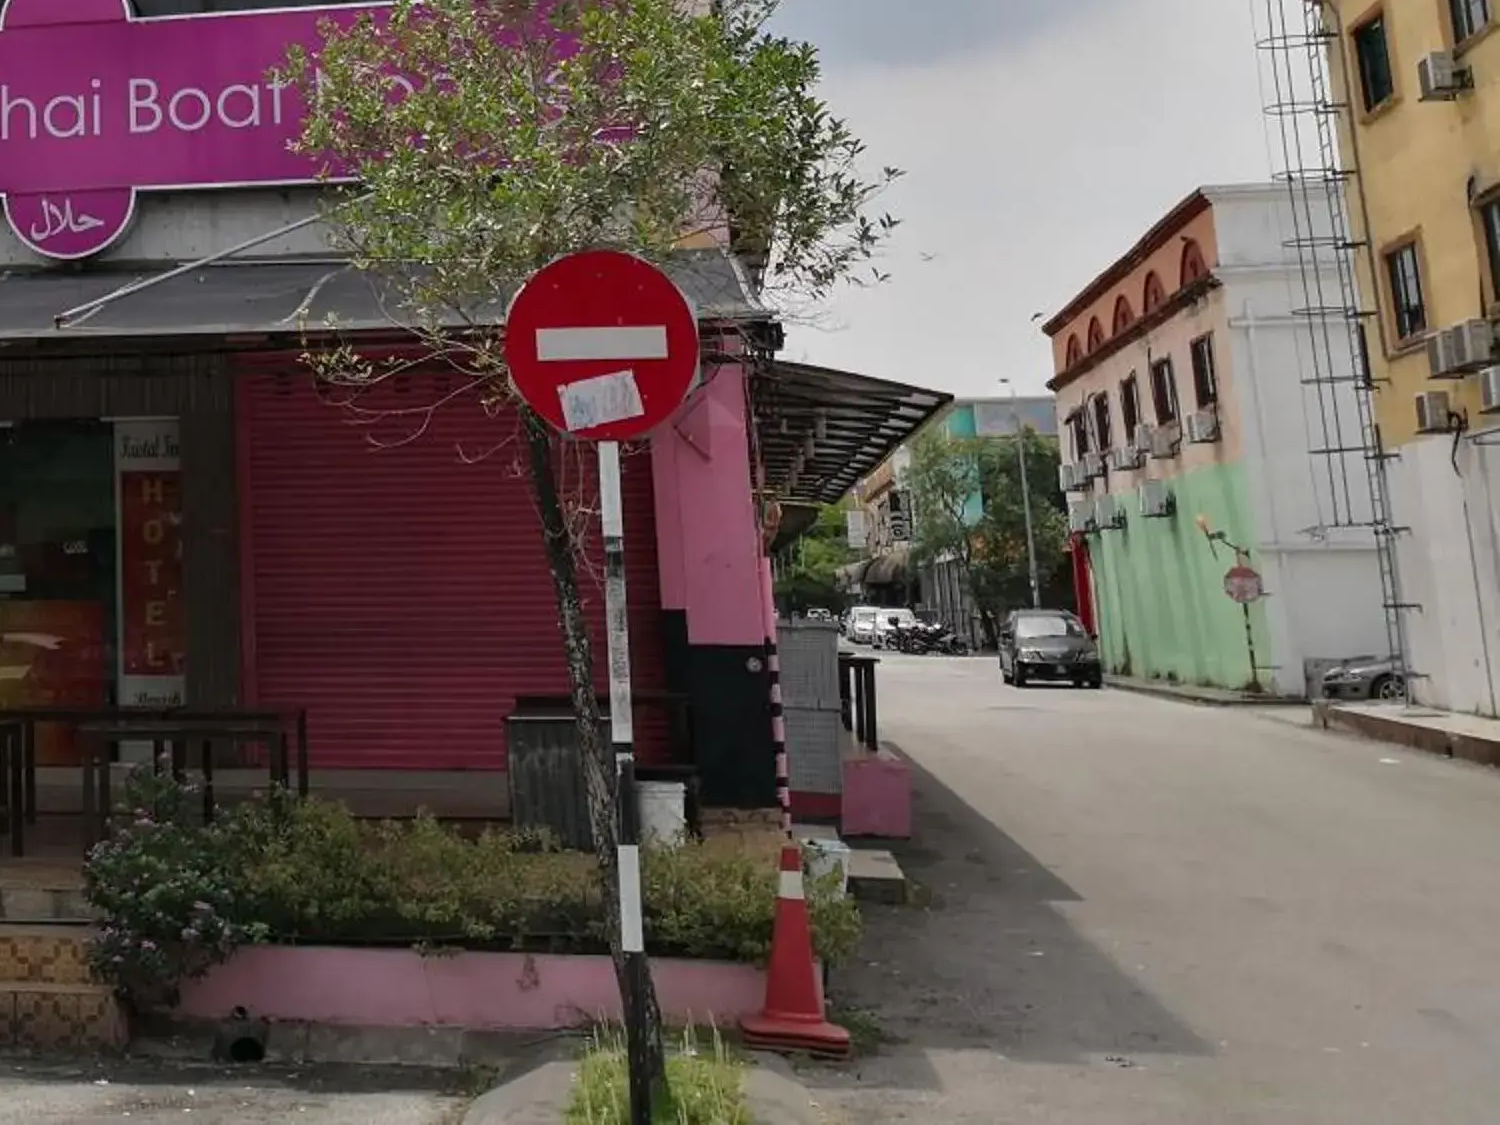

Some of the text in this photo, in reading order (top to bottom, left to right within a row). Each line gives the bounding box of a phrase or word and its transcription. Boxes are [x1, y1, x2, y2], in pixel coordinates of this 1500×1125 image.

[128, 69, 286, 135] Boat
[30, 196, 104, 241] حلال
[141, 479, 168, 668] HOTEL
